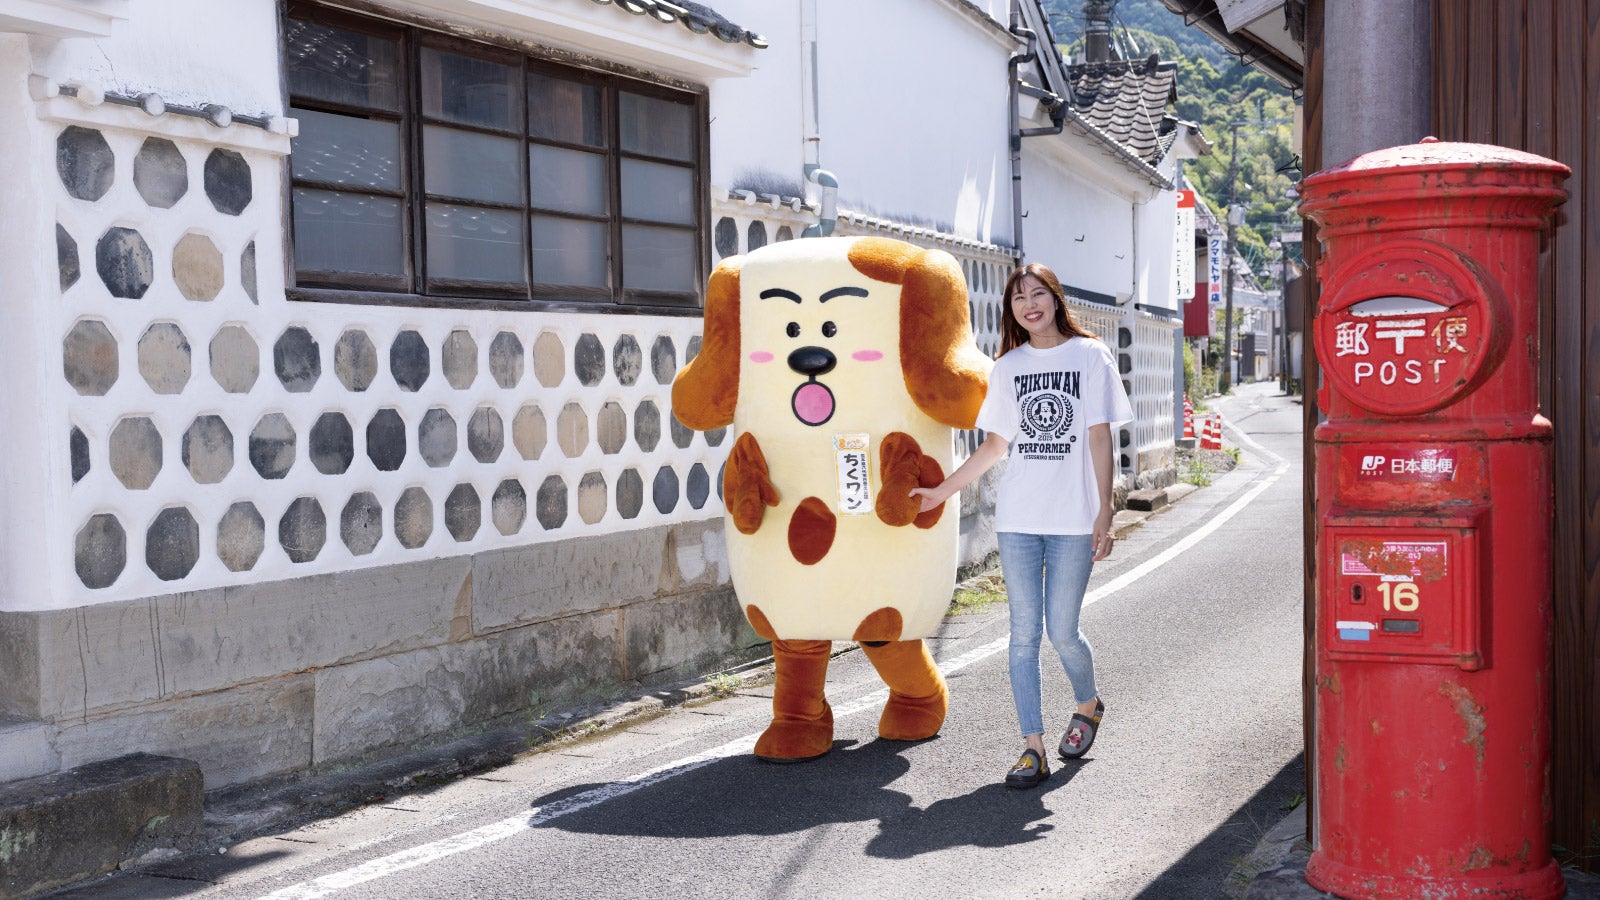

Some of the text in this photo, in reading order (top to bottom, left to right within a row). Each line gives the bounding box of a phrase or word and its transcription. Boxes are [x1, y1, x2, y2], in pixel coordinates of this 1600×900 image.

[1355, 359, 1447, 385] POST
[1014, 371, 1081, 403] CHIKUWAN
[1018, 443, 1071, 454] PERFORMER
[1391, 458, 1453, 474] 日本郵便
[844, 453, 862, 510] ちくワン
[1377, 582, 1420, 612] 16
